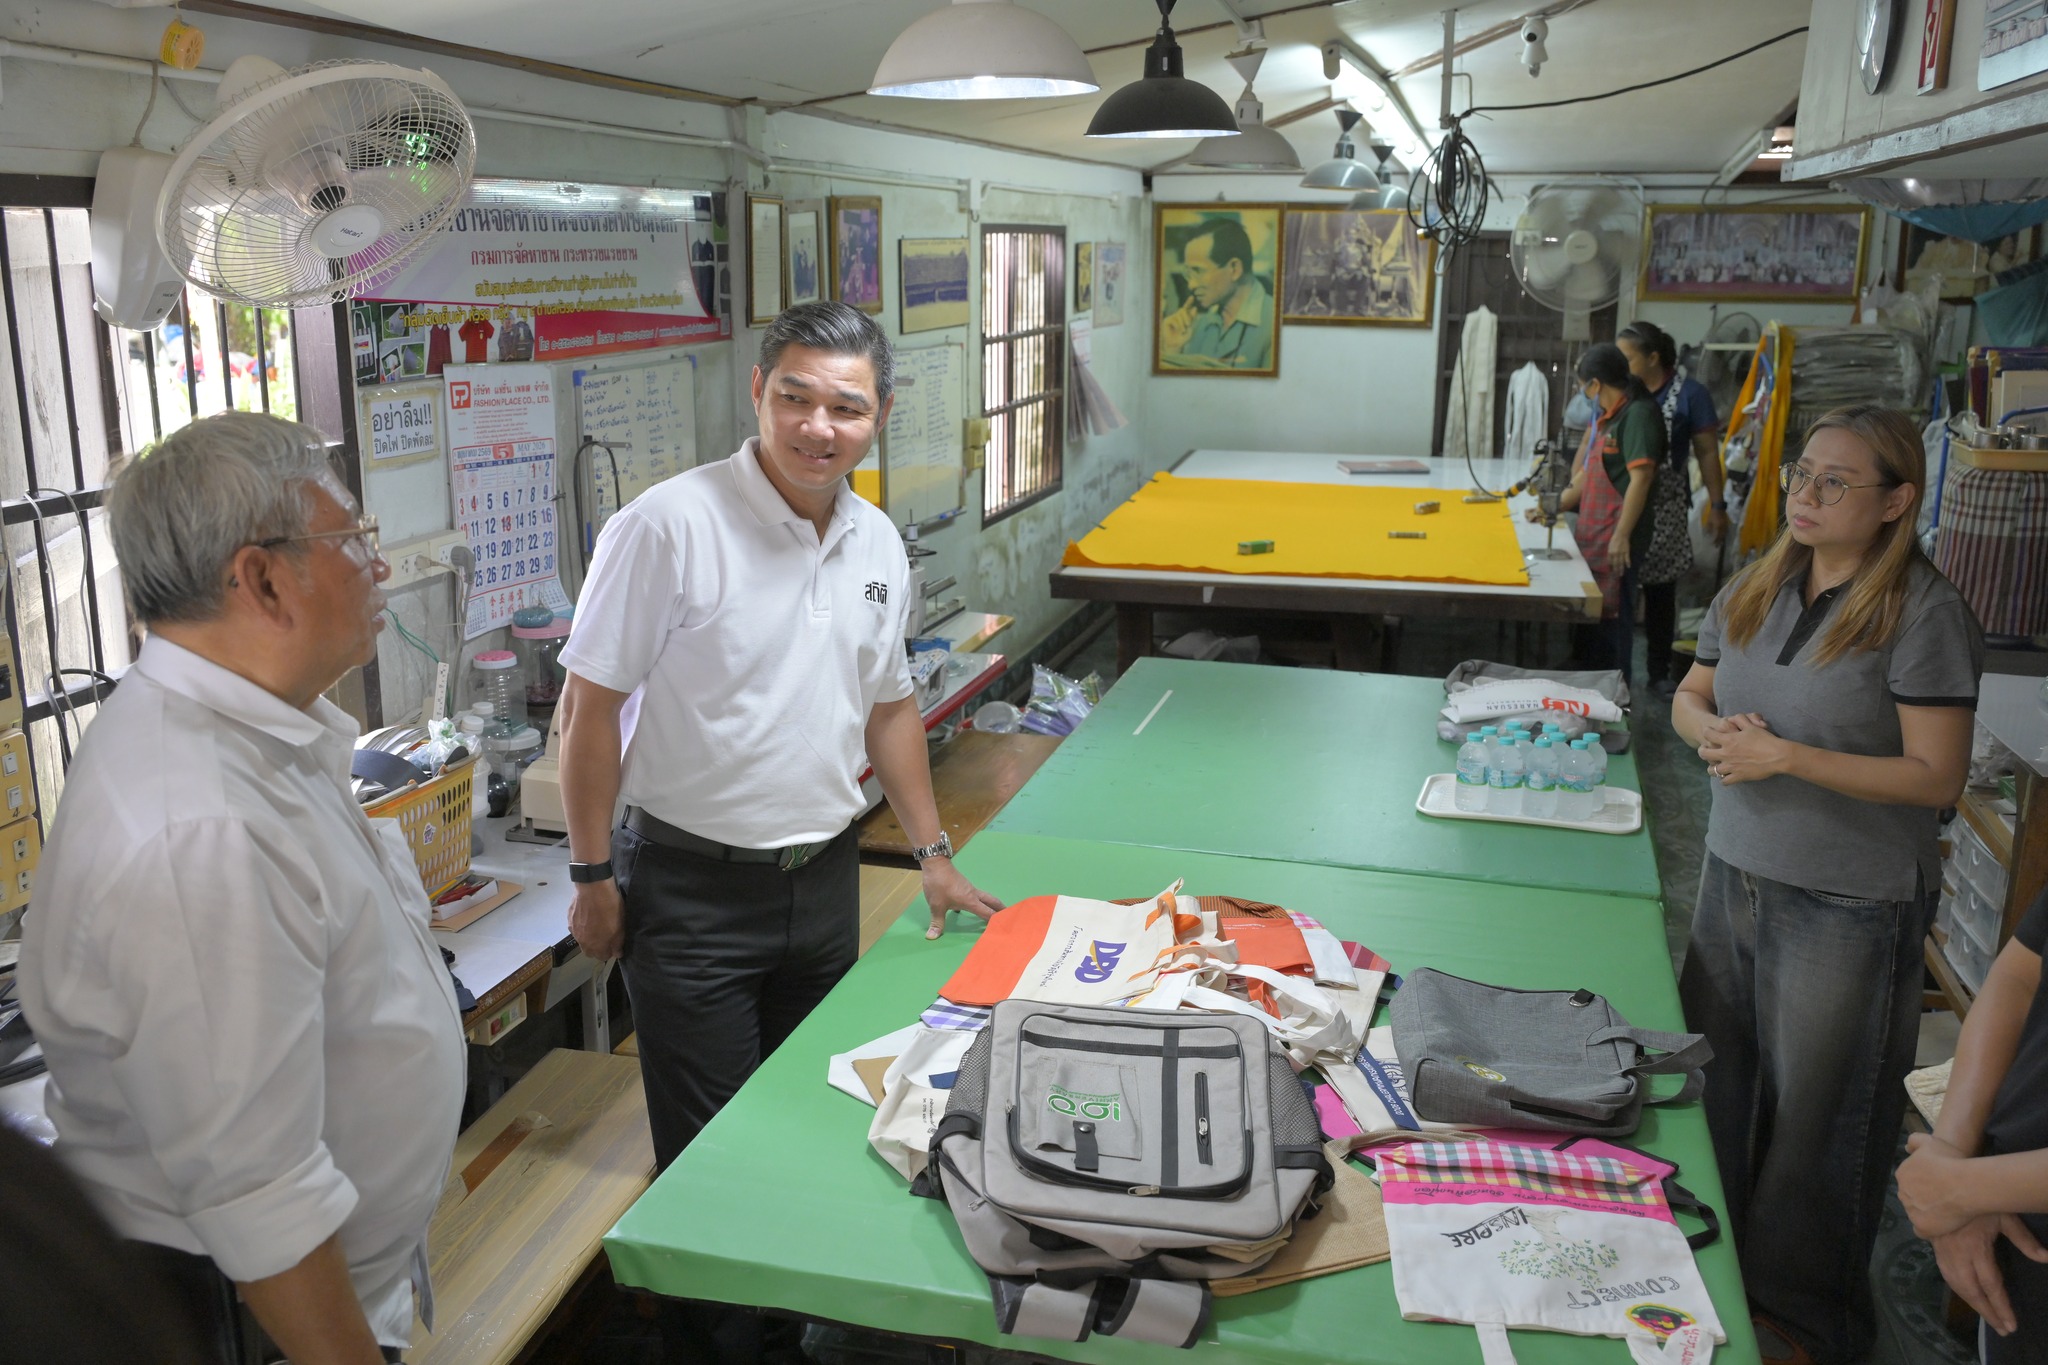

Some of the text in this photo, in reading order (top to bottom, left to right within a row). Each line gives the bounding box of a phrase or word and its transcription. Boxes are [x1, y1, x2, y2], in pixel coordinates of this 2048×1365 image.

[471, 242, 638, 265] กรมการจัดหางาน กระทรวงแรงงาน
[501, 397, 522, 406] PLACE
[372, 400, 432, 432] อย่าลืม!!
[373, 432, 433, 454] ปิดไฟ ปิดพัดลม
[498, 445, 510, 459] 5
[517, 442, 530, 452] MAY
[531, 463, 537, 478] 1
[544, 461, 550, 477] 2
[459, 485, 548, 515] 3 4 5 6 7 8 9
[471, 520, 479, 537] 11
[485, 518, 496, 534] 12
[501, 515, 512, 532] 13
[515, 512, 524, 529] 14
[528, 510, 537, 526] 15
[541, 507, 552, 525] 16
[473, 531, 553, 562] 18 19 20 21 22 23
[475, 554, 553, 587] 25 26 27 28 29 30
[865, 581, 888, 605] สถิติ
[1486, 703, 1539, 711] NARESUAN
[1074, 939, 1127, 983] DBD
[1443, 1206, 1529, 1248] INSPIRE
